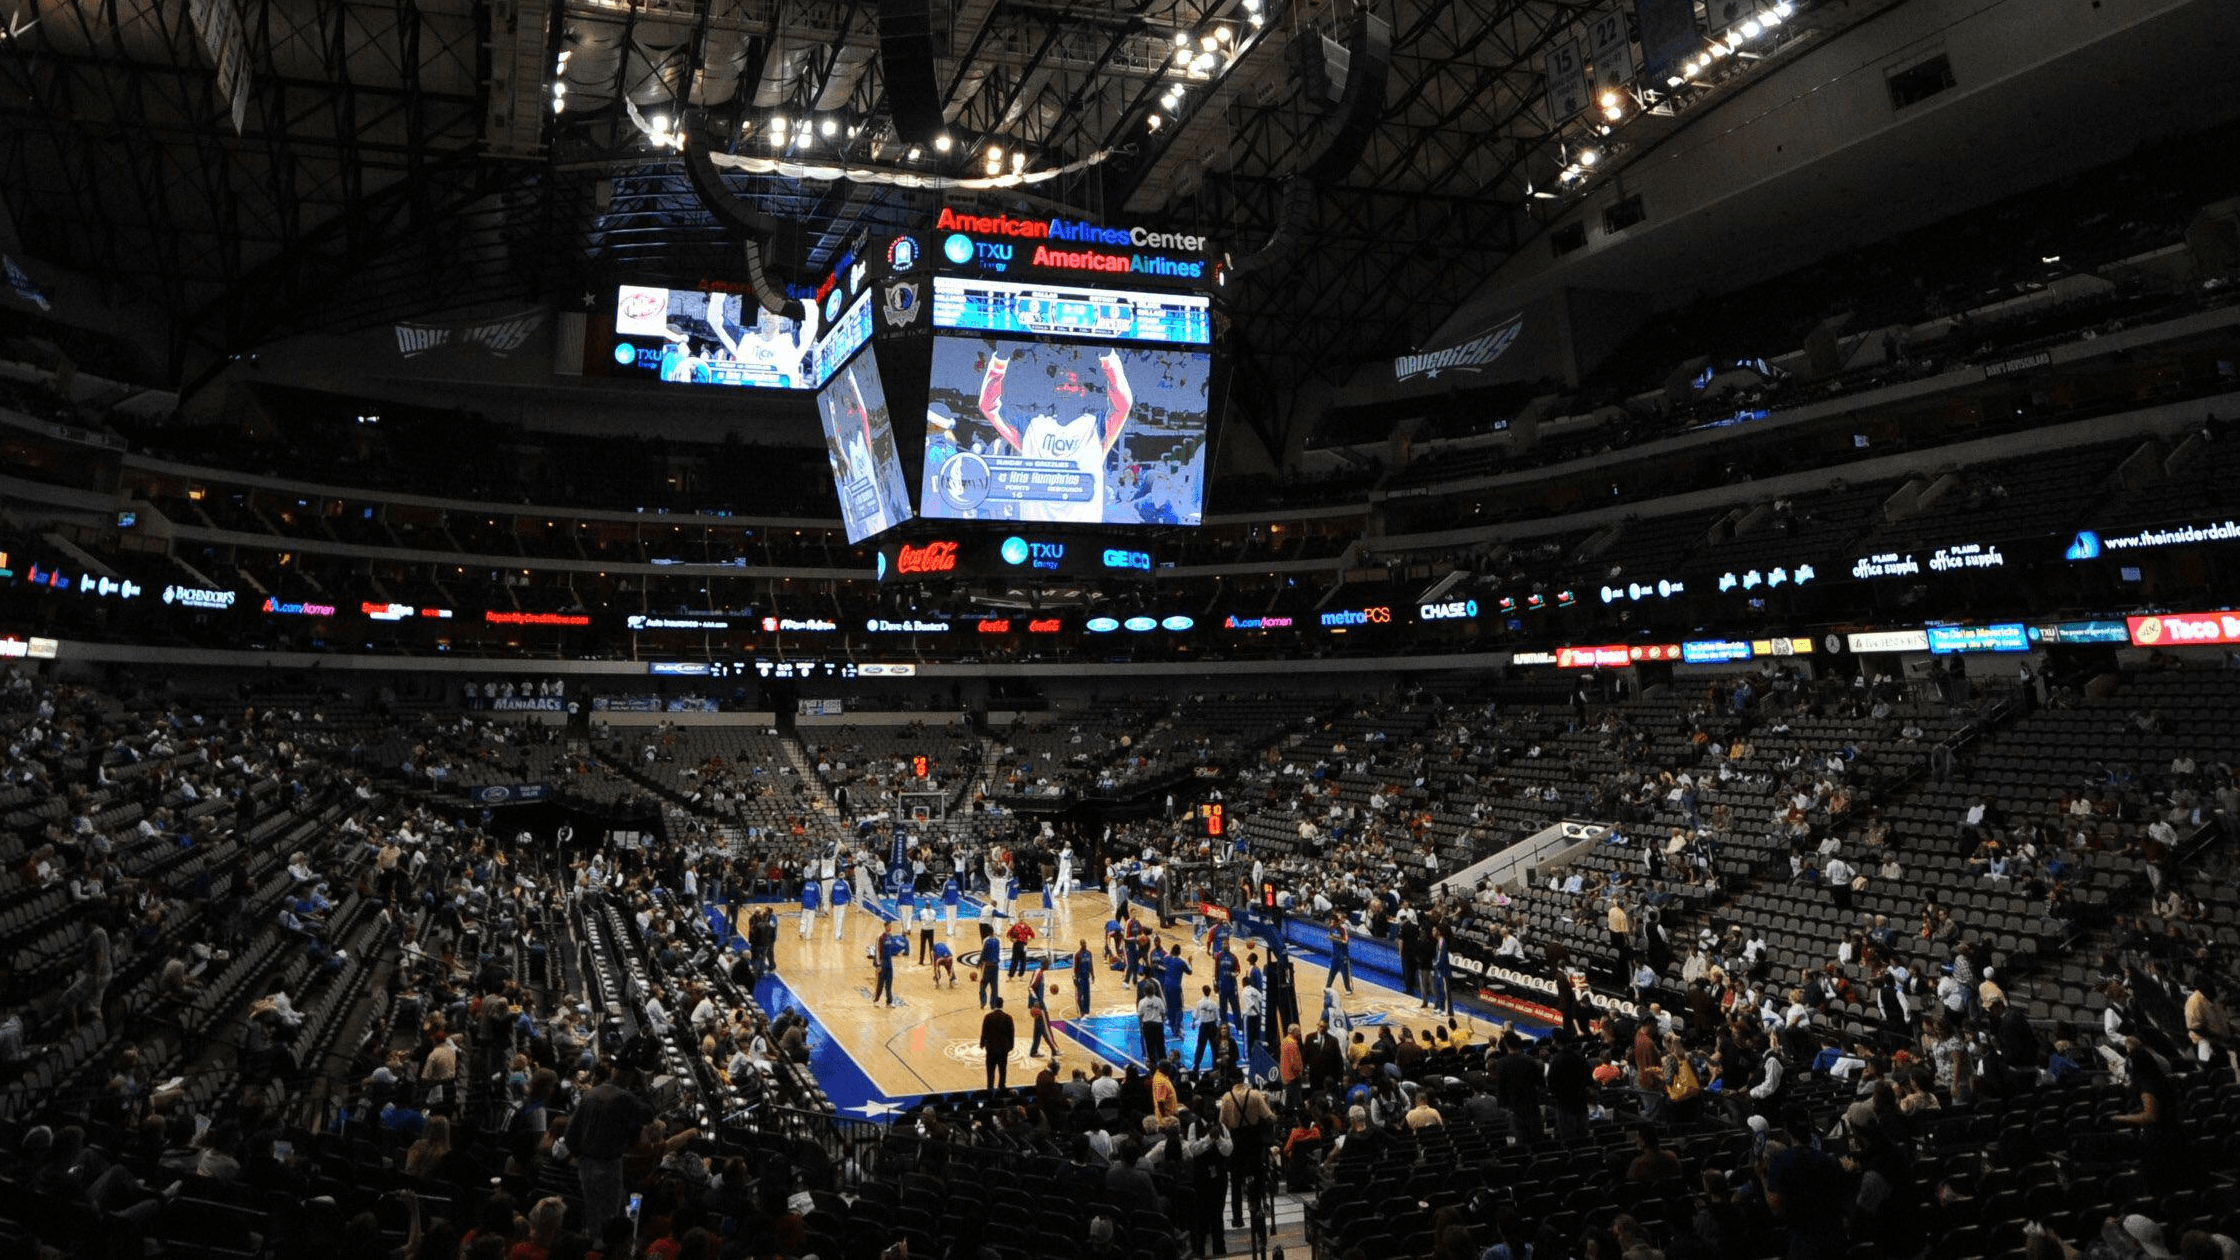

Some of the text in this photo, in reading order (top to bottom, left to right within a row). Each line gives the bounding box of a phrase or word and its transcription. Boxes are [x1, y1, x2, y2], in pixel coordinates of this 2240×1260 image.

[1554, 49, 1573, 75] 15
[977, 242, 1013, 260] TXU
[637, 349, 662, 361] TXU
[1395, 321, 1524, 379] MAVERICKS
[1030, 543, 1064, 558] TXU
[1951, 544, 1980, 555] PLANO
[1033, 559, 1058, 569] Energy
[1104, 550, 1150, 571] GEICO
[1852, 555, 1919, 578] office supply
[1872, 553, 1899, 564] PLANO
[1930, 546, 2003, 572] office supply
[1321, 607, 1391, 625] metroPCS
[1421, 602, 1466, 619] CHASE
[880, 620, 949, 632] Dave & Buster's
[2039, 629, 2055, 637] TXU
[2164, 618, 2219, 640] Taco
